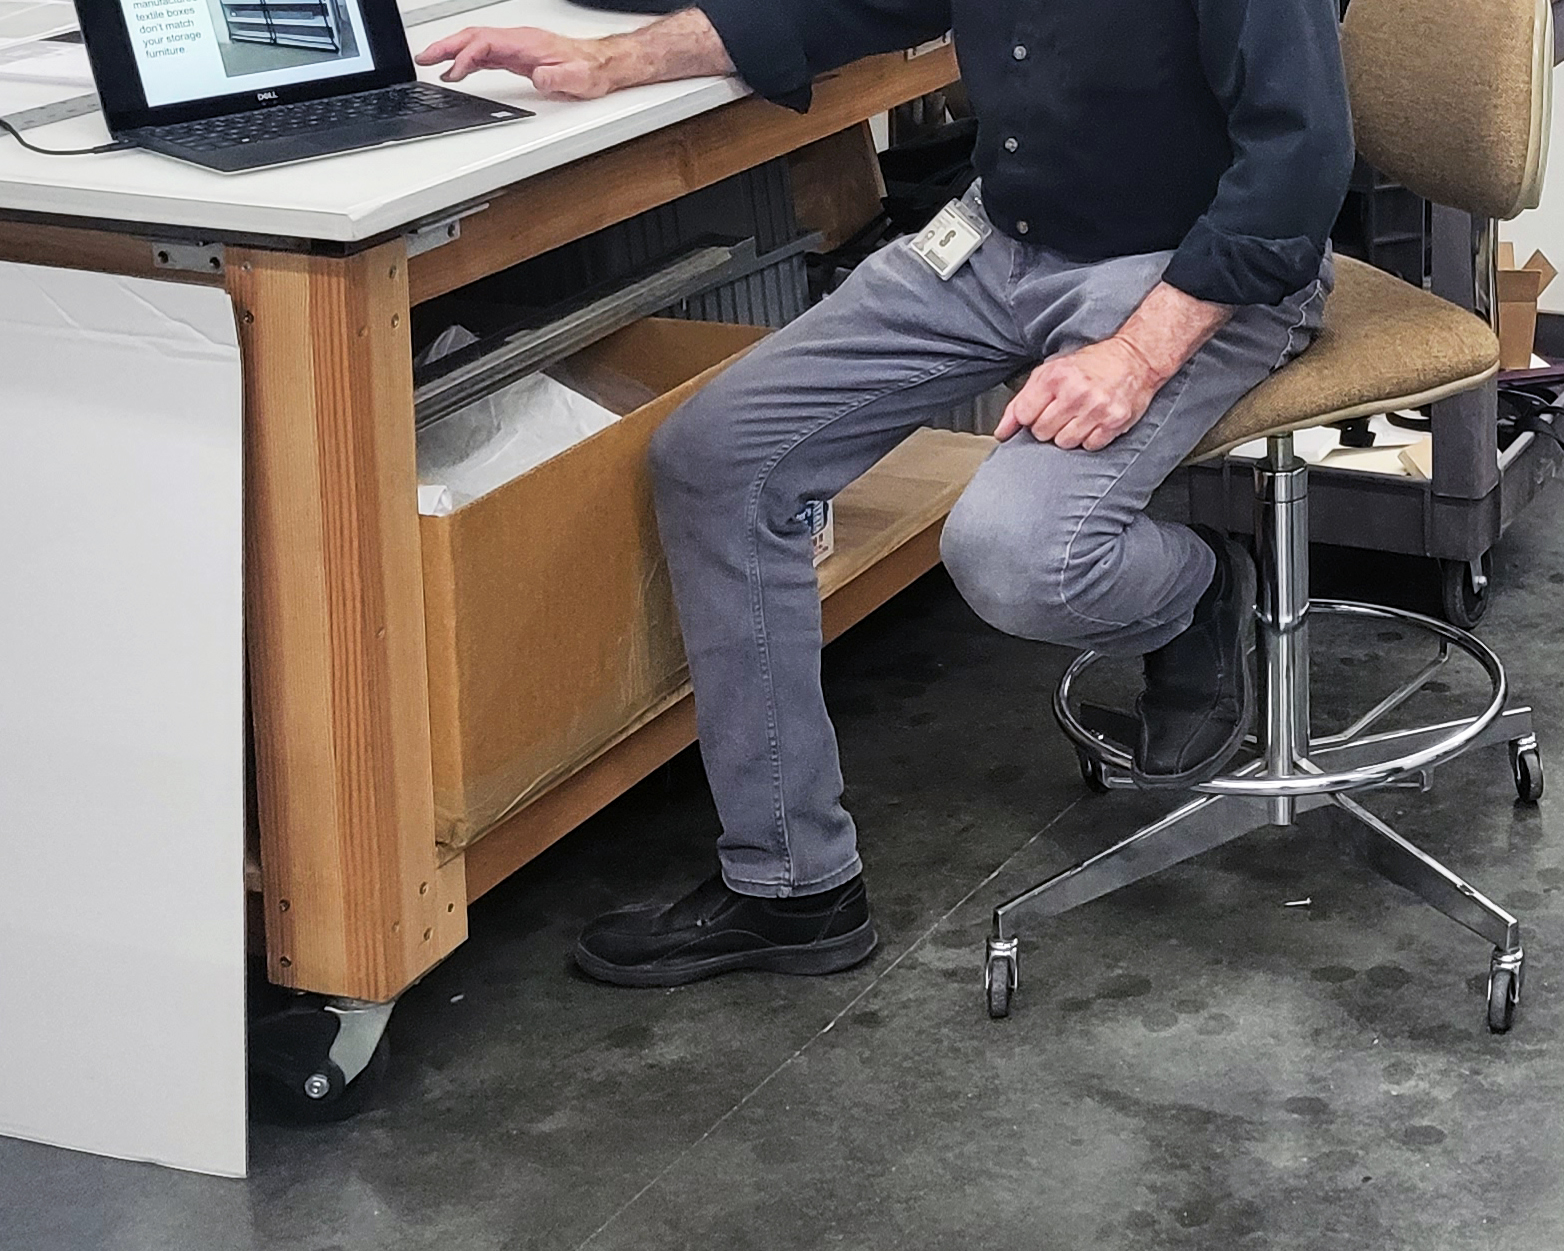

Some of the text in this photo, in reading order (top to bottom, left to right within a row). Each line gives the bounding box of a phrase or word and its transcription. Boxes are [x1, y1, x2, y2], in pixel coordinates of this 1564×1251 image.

[136, 7, 195, 22] textile boxes
[166, 19, 195, 29] match
[142, 32, 202, 48] your storage
[257, 90, 279, 101] DELL
